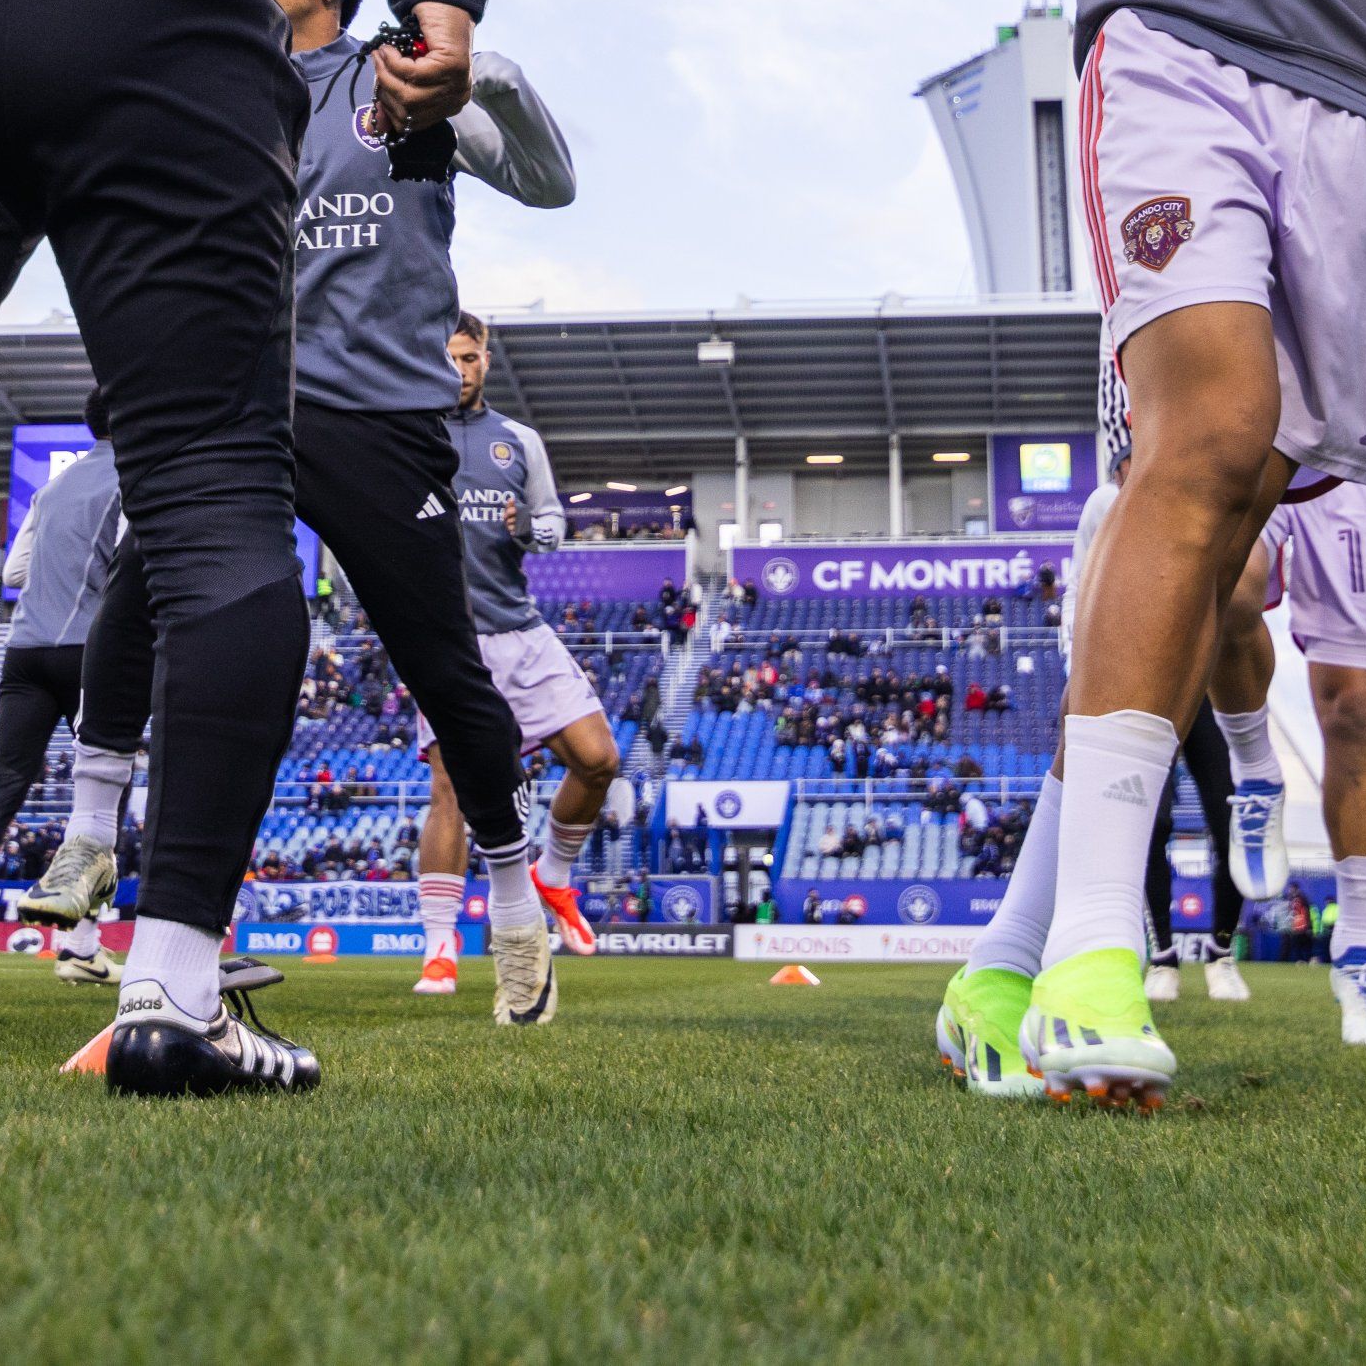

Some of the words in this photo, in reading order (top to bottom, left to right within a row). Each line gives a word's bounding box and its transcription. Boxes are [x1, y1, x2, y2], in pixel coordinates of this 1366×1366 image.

[295, 192, 395, 223] ANDO
[1125, 204, 1162, 231] ORLANDO
[1163, 202, 1183, 211] CITY
[457, 488, 516, 505] ANDO
[812, 560, 866, 591] CF
[247, 932, 302, 951] BMO
[371, 932, 426, 951] BMO
[594, 933, 732, 952] HEVROLET
[766, 937, 852, 954] ADONIS
[119, 996, 164, 1016] adidas
